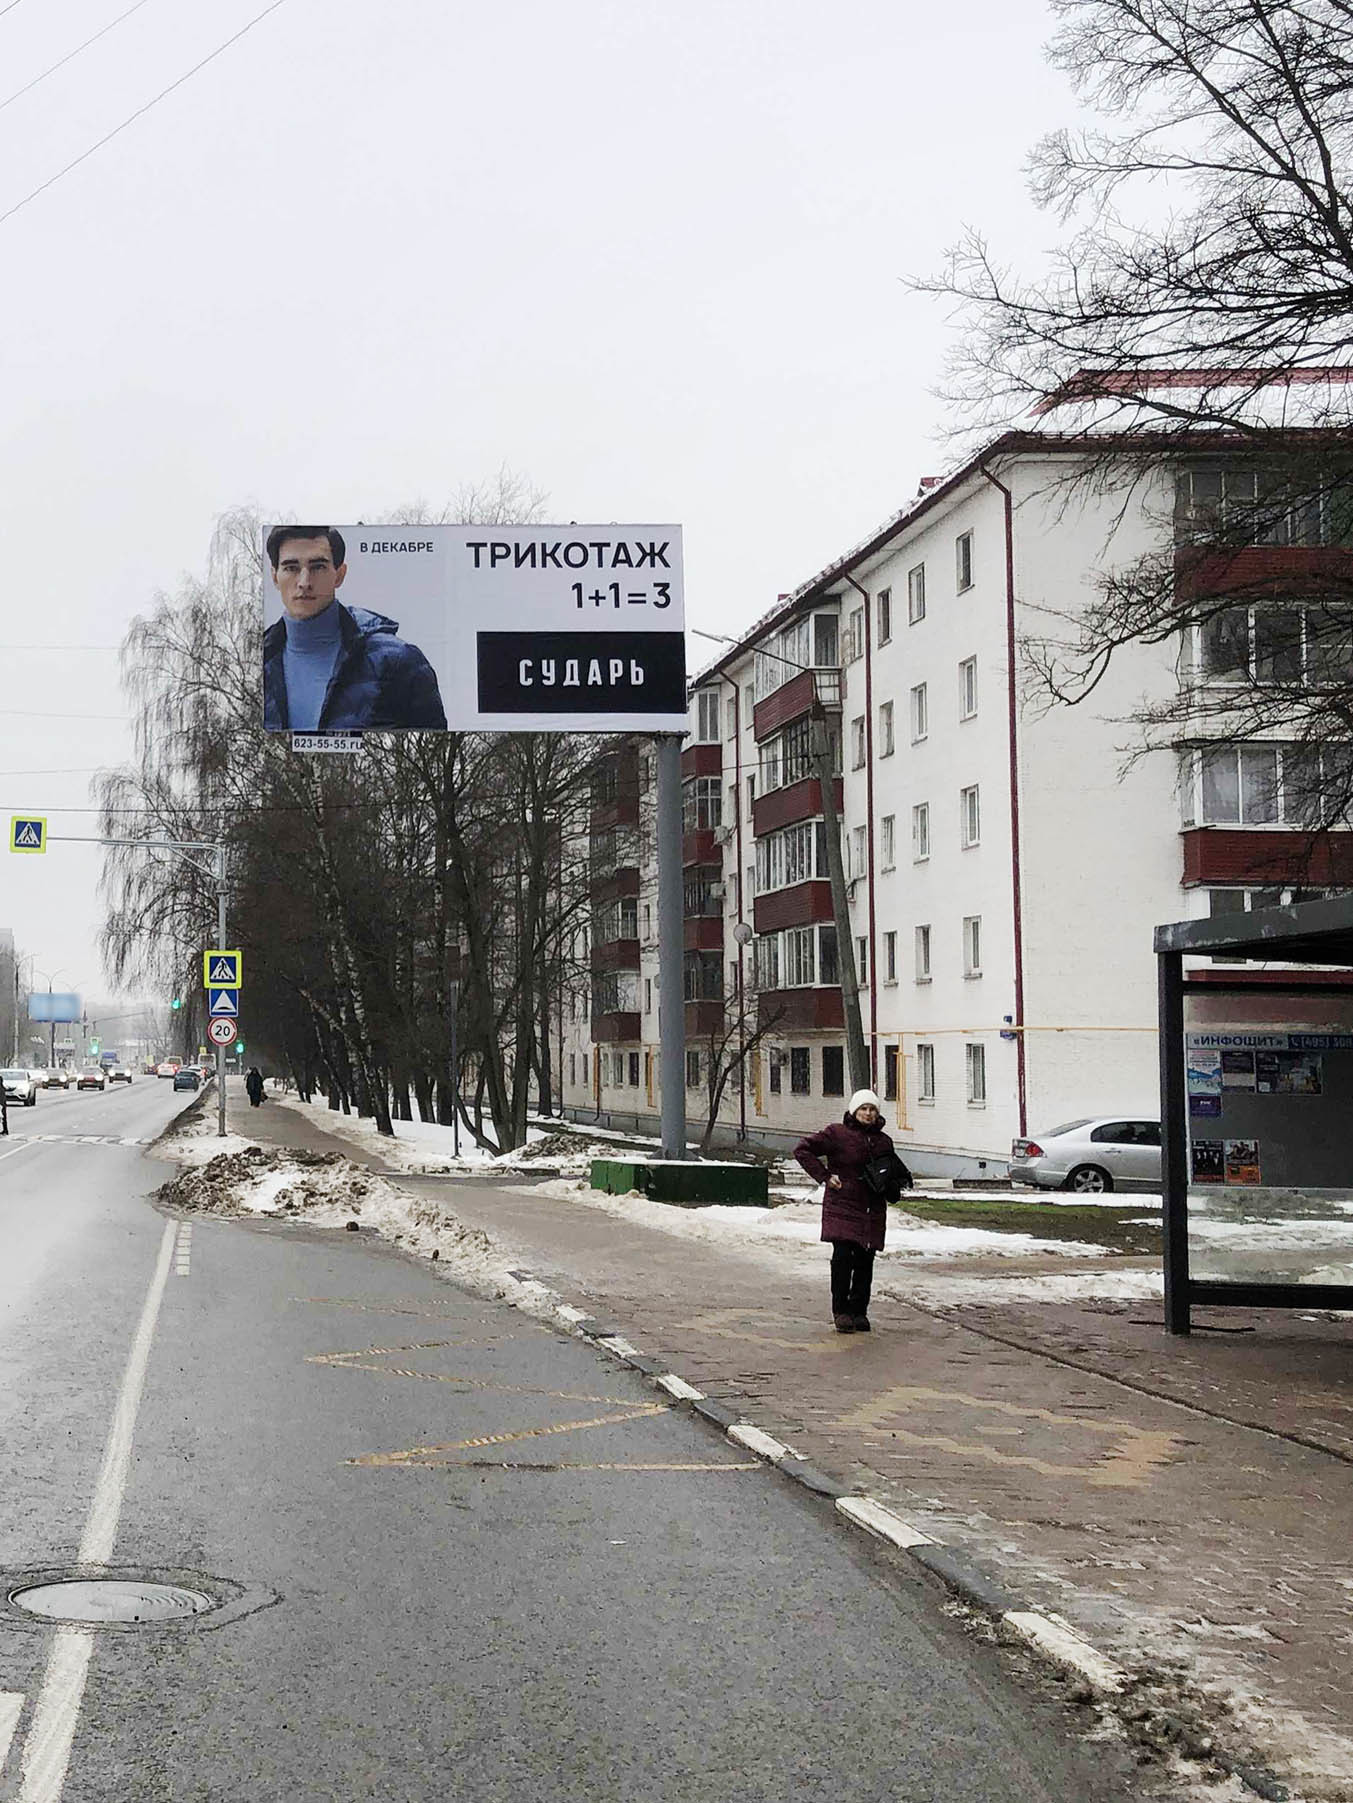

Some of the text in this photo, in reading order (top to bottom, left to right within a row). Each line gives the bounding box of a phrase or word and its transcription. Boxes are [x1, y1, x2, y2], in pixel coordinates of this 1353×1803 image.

[360, 542, 433, 553] В ДЕКАБРЕ
[466, 542, 671, 568] ТРИКОТАЖ
[571, 582, 671, 608] 1+1=3
[519, 659, 644, 686] СУДАРЬ
[294, 738, 363, 749] 623-55-55.ru
[215, 1025, 231, 1037] 20
